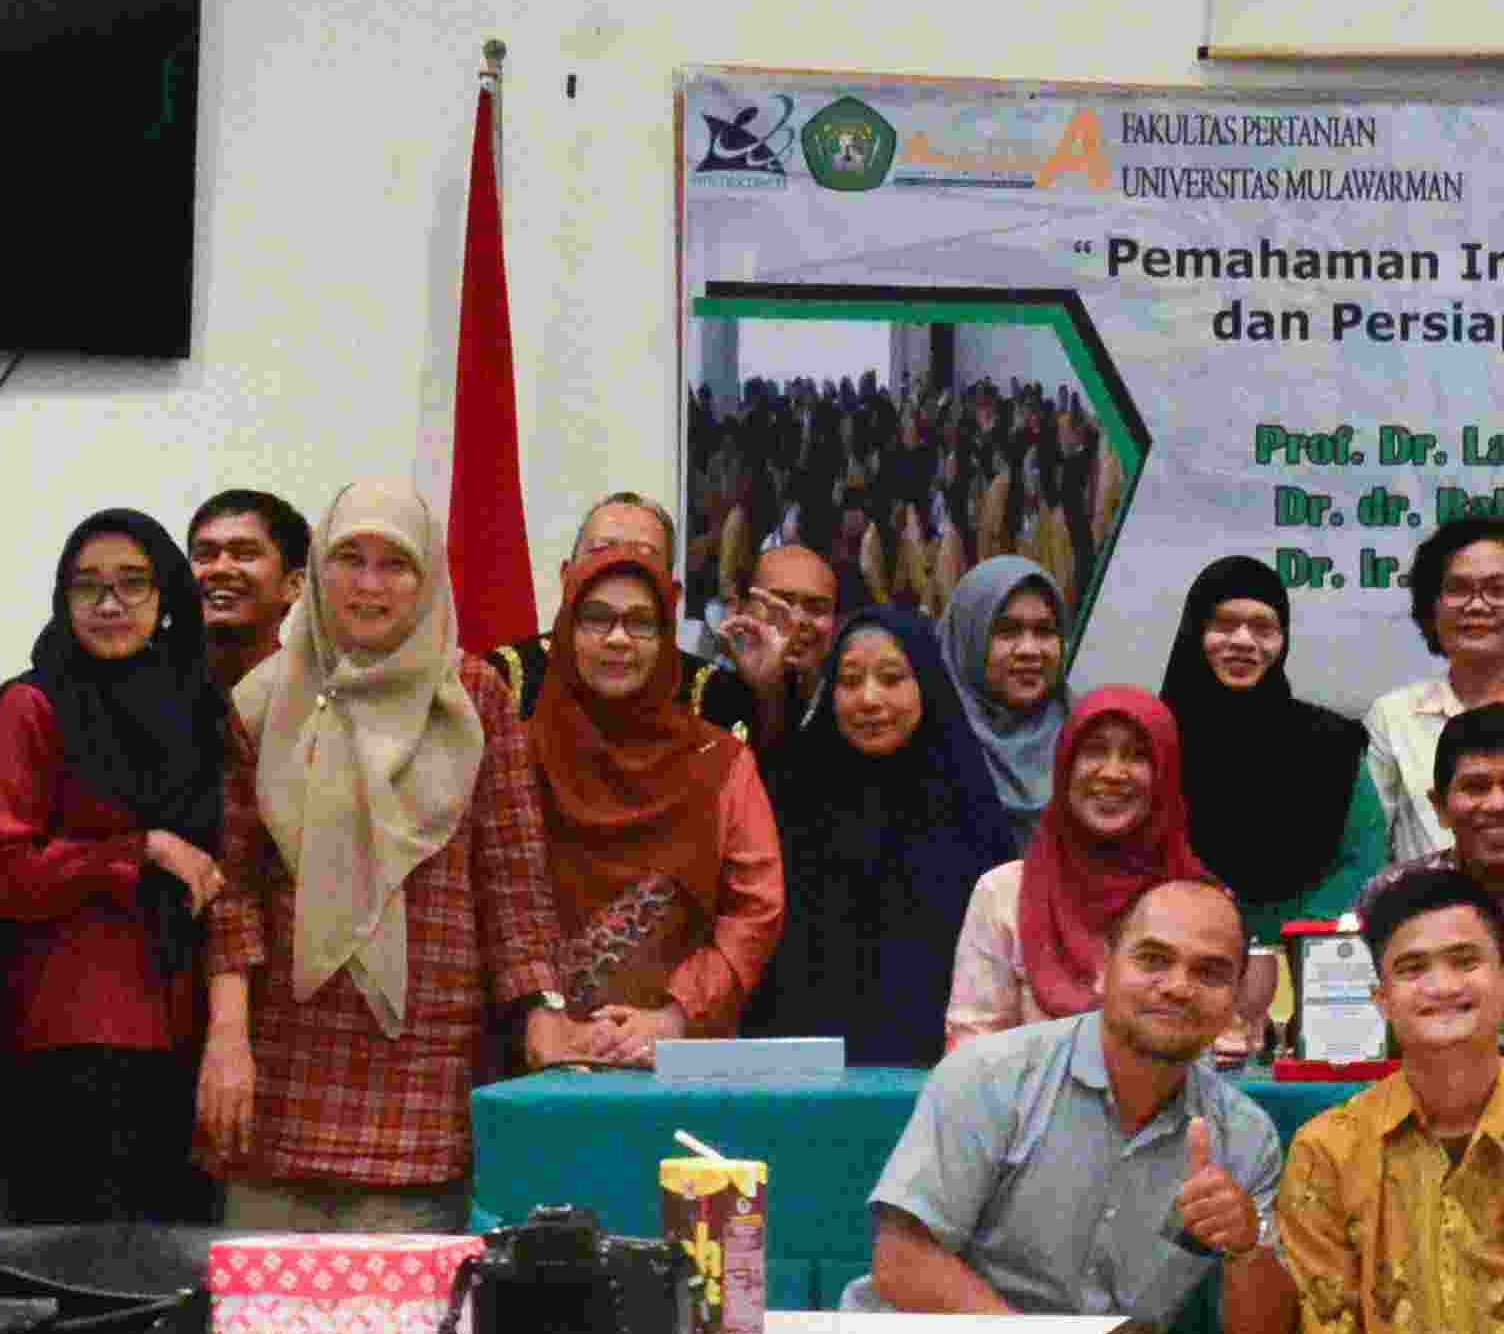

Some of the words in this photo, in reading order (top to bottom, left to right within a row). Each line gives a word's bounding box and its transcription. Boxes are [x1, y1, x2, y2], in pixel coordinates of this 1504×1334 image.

[1120, 112, 1238, 145] FAKULTAS
[1242, 115, 1377, 148] PERTANIAN
[1120, 166, 1280, 200] UNIVERSITAS
[1284, 169, 1464, 203] MULAWARMAN
[1212, 300, 1310, 342] dan
[1254, 423, 1366, 467] Prof.
[1378, 425, 1448, 467] Dr.
[1275, 485, 1345, 527] Dr.
[1357, 486, 1423, 527] dr.
[1275, 547, 1346, 590] Dr.
